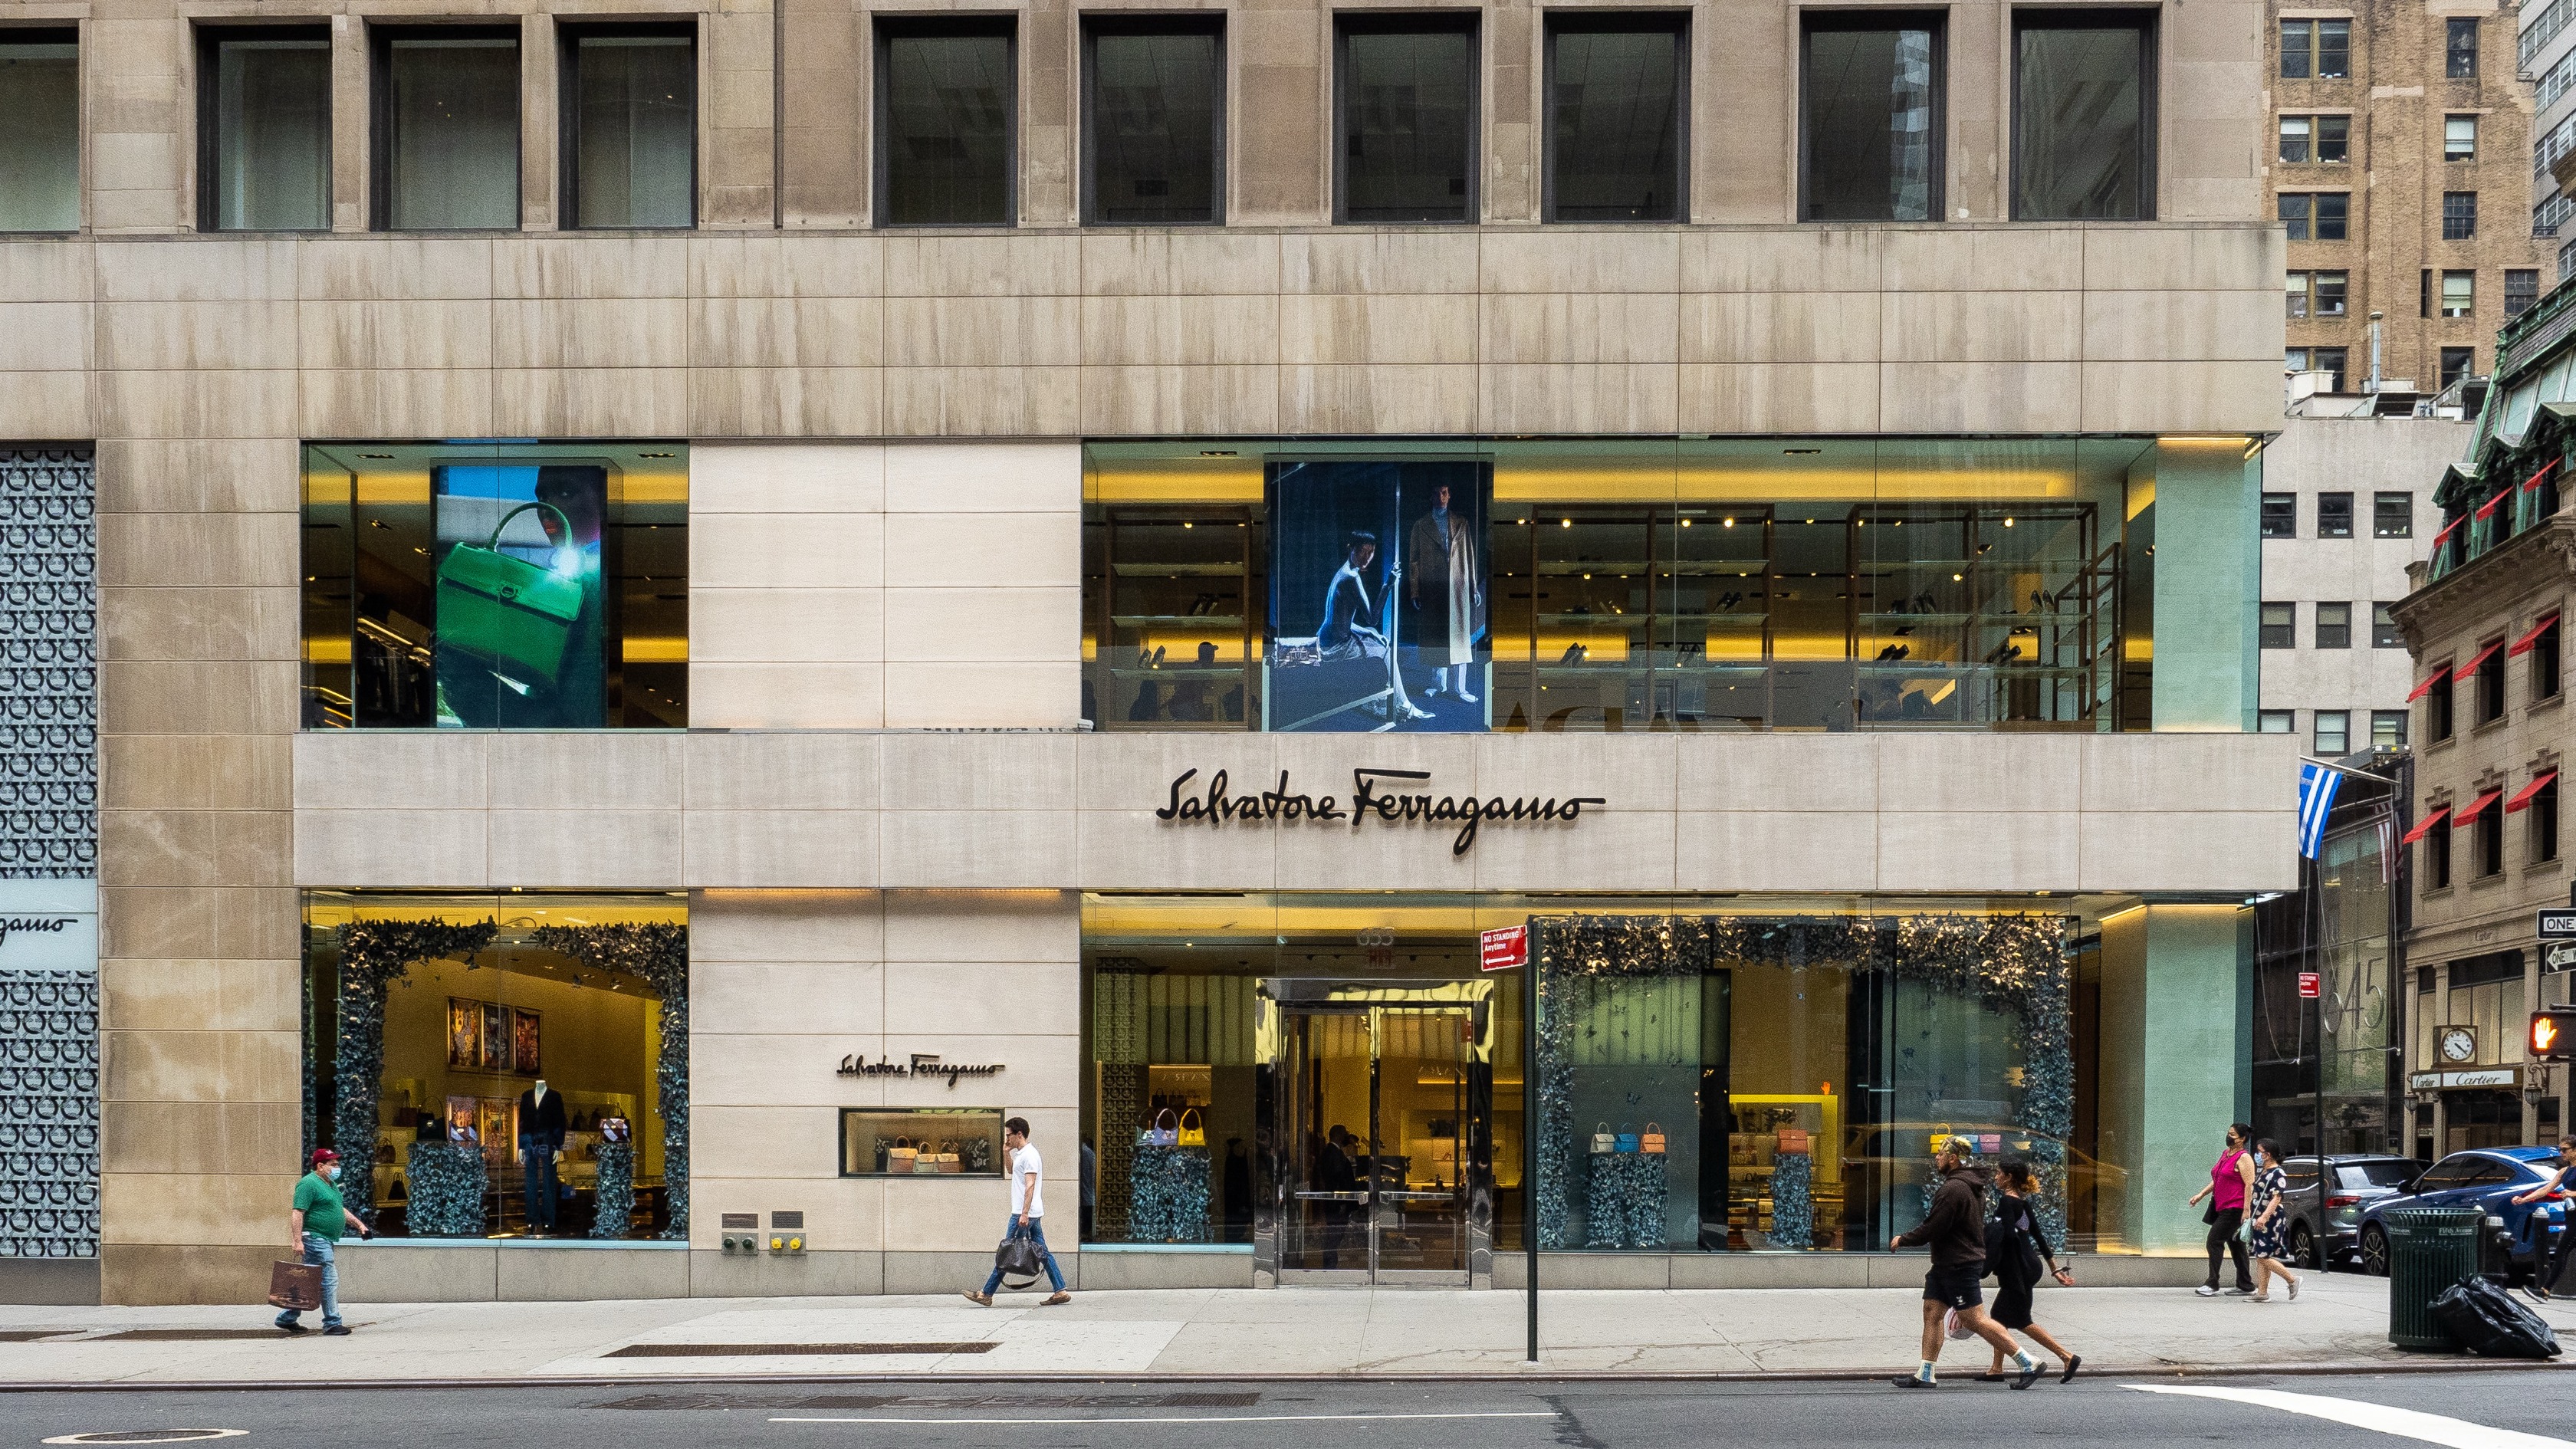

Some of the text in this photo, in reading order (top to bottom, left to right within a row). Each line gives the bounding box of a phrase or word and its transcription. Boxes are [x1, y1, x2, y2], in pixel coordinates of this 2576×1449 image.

[1156, 767, 1607, 856] Salvatore Ferragamo
[2546, 918, 2575, 930] ONE
[1493, 930, 1520, 942] STANDING
[1484, 942, 1507, 952] Anytime
[2551, 951, 2566, 964] ONE
[836, 1053, 1006, 1088] Salvatore Ferragamo
[2456, 1072, 2501, 1086] Cartier
